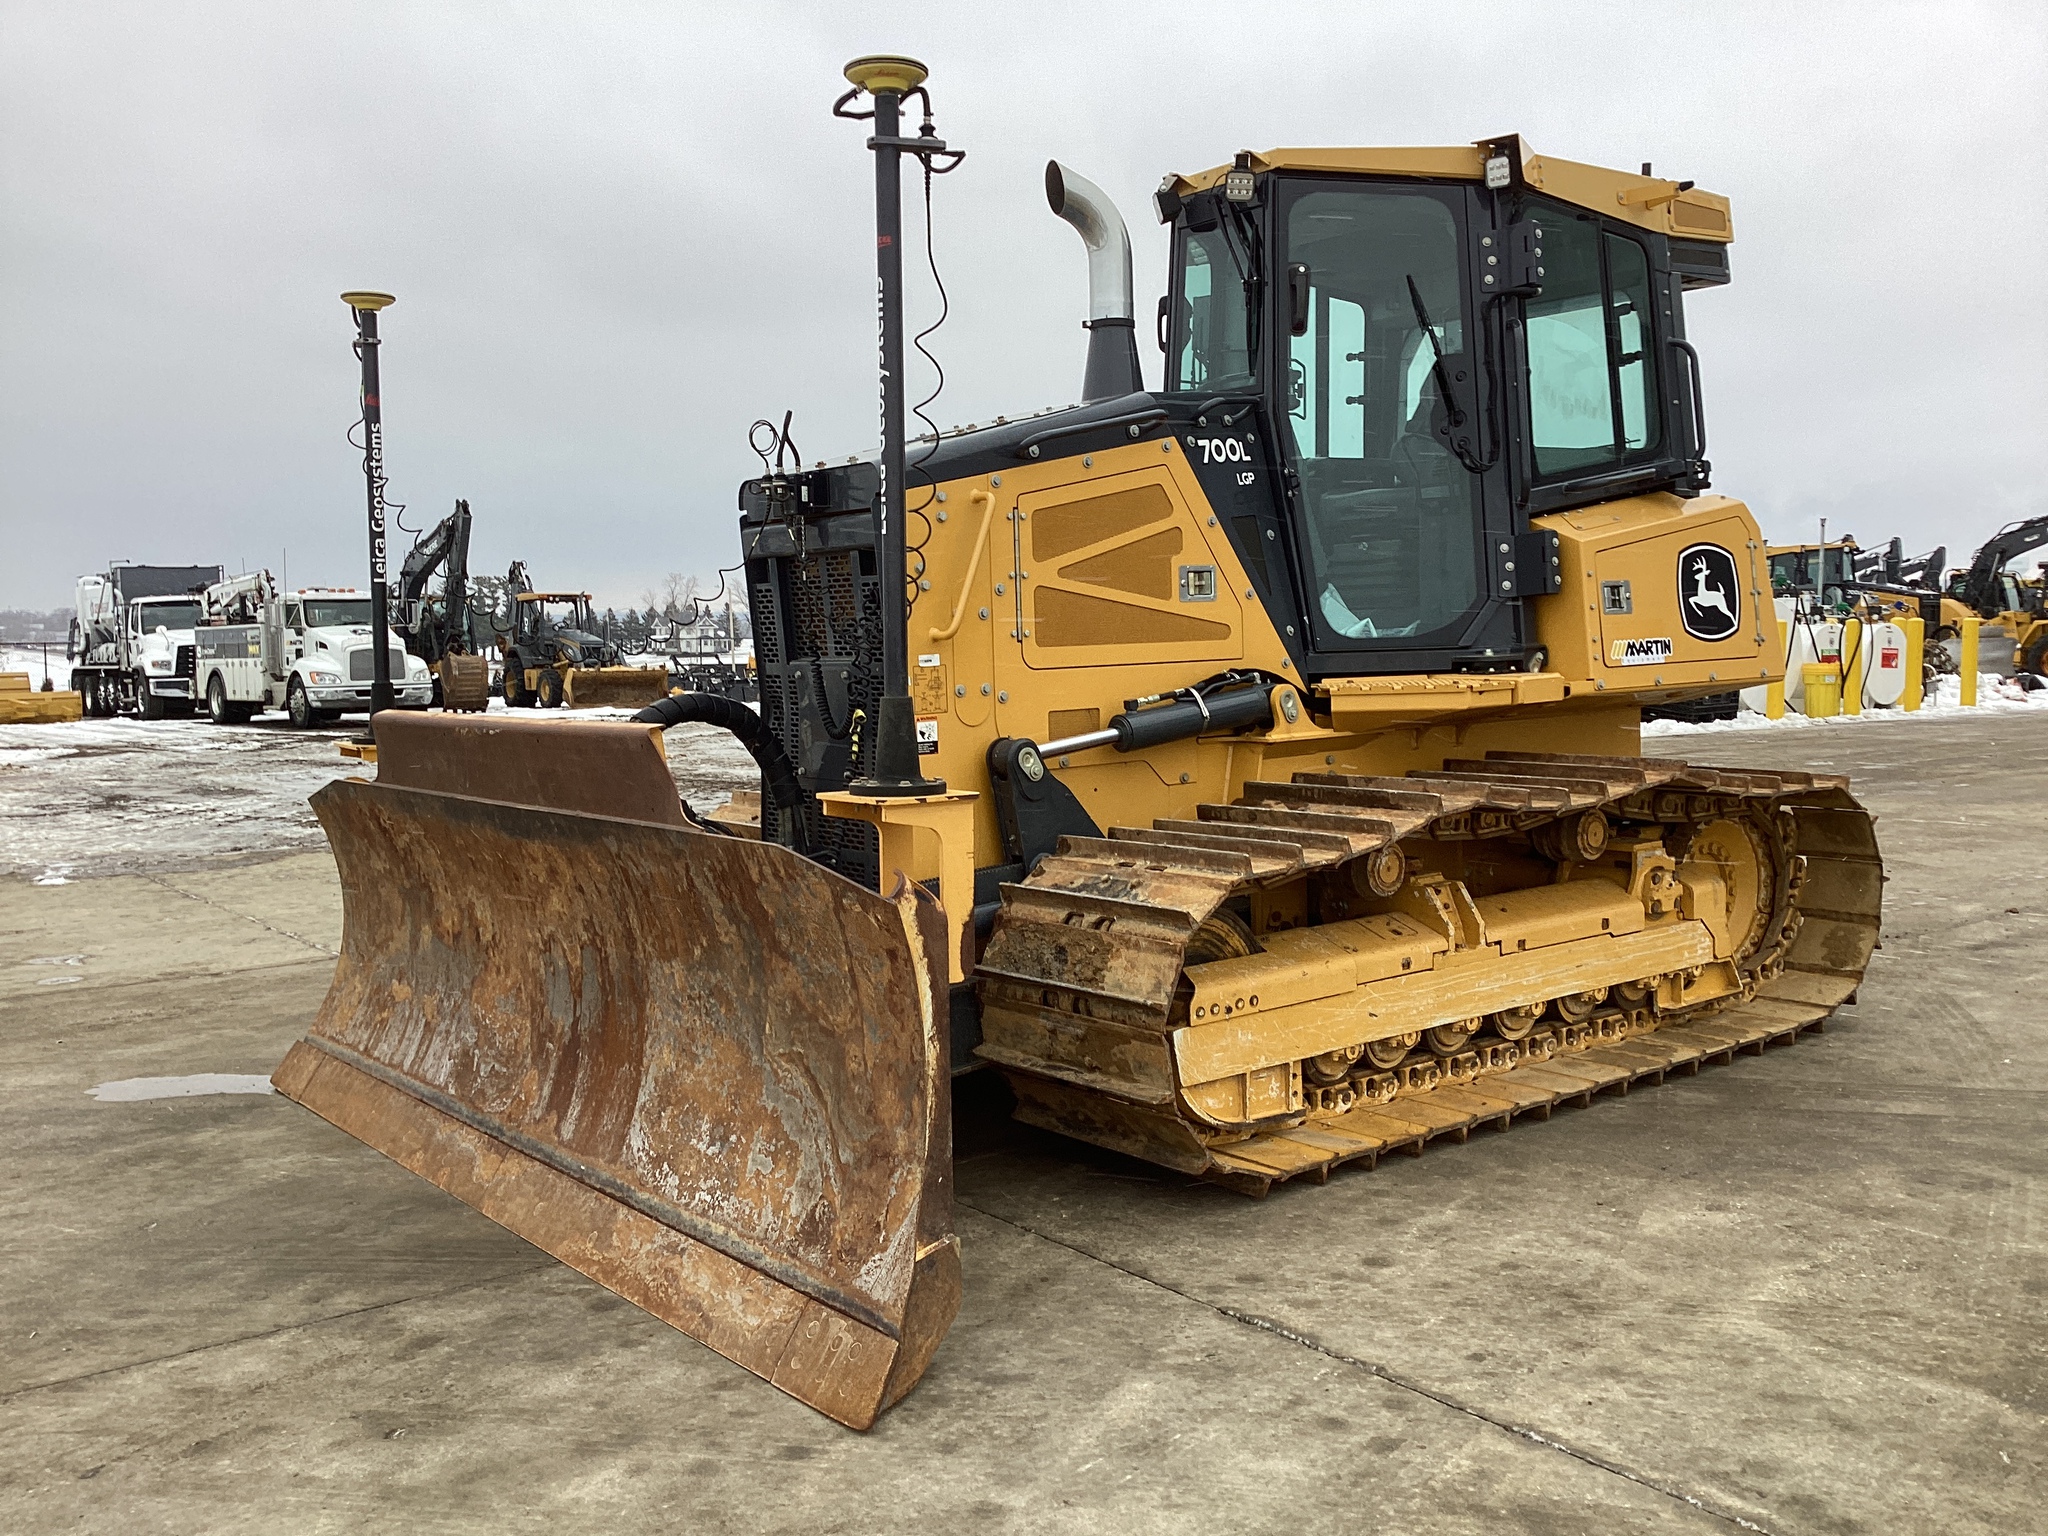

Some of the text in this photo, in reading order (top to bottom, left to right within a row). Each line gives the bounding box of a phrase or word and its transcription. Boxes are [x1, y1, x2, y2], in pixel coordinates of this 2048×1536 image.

[1197, 437, 1251, 463] 700L
[1236, 472, 1255, 485] LGP
[371, 422, 386, 583] Leica Geosystems
[1625, 639, 1671, 657] MARTIN
